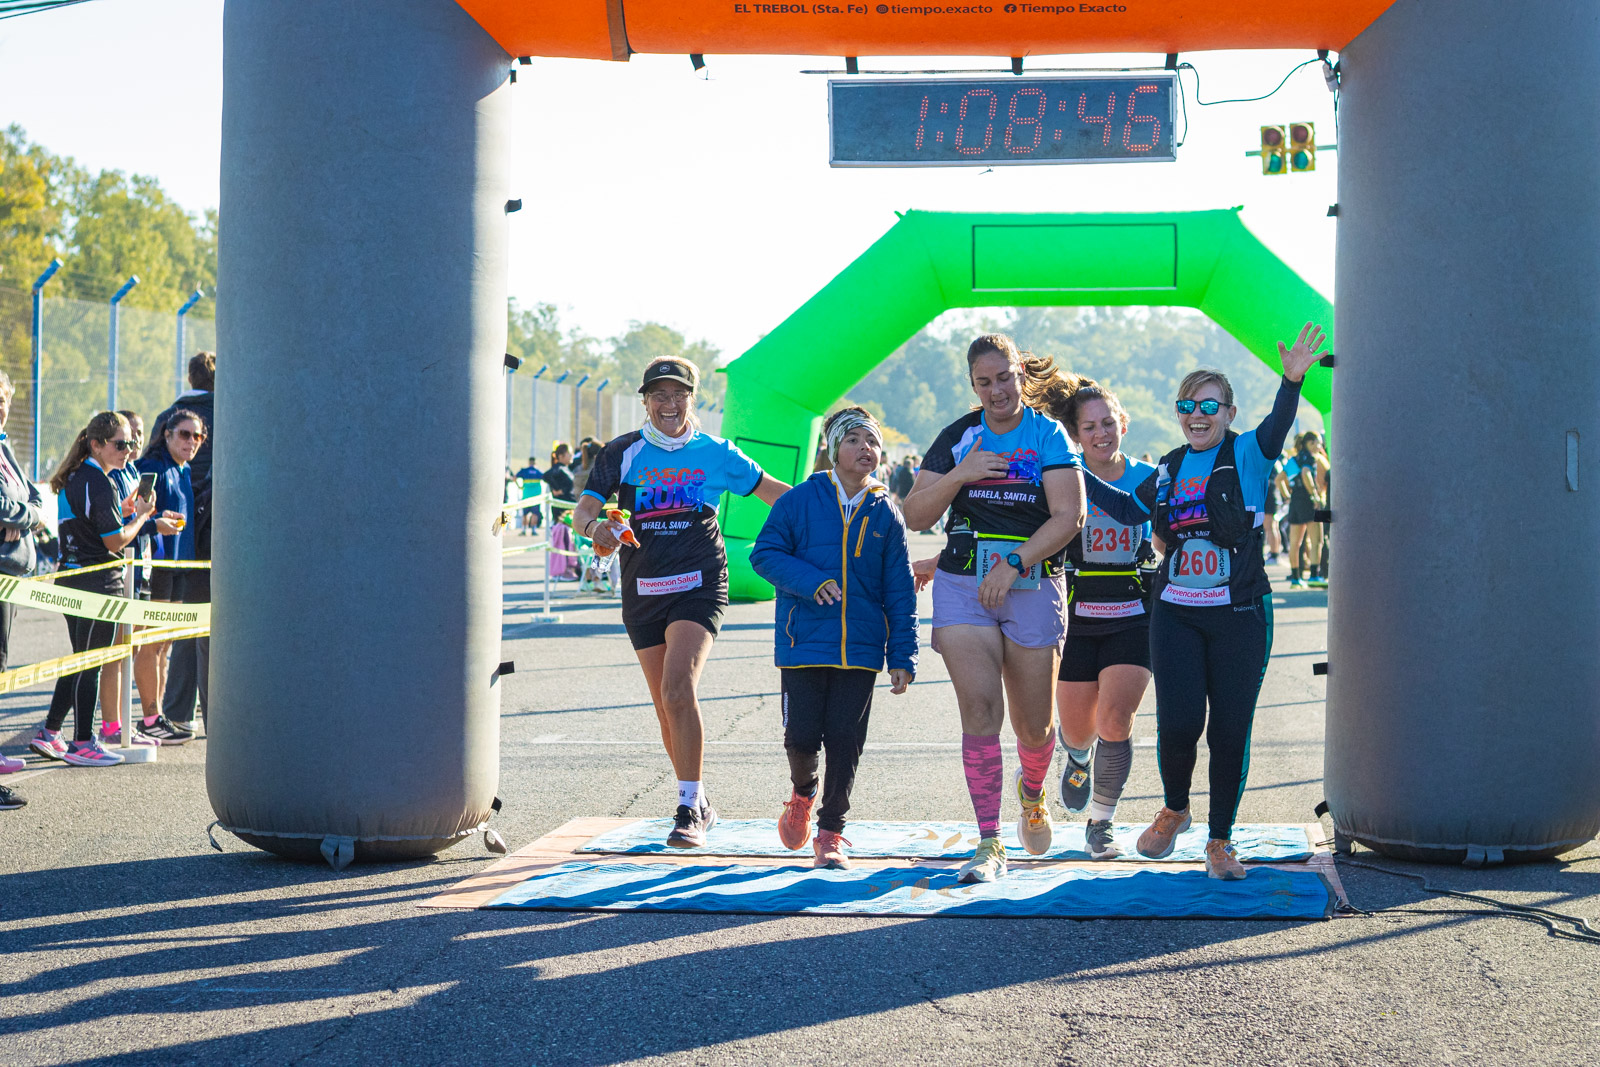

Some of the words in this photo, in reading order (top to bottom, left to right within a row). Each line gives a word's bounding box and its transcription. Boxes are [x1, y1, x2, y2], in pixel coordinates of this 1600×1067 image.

[734, 4, 751, 13] EL
[753, 4, 809, 13] TREBOL
[812, 4, 844, 14] (Sta.
[848, 4, 868, 14] Fe)
[891, 4, 993, 15] tiempo.exacto
[1019, 4, 1075, 14] Tiempo
[1079, 4, 1127, 13] Exacto
[915, 85, 1161, 154] 1:08:46
[969, 490, 1001, 500] RAFAELA,
[1003, 492, 1027, 501] SANTA
[1028, 494, 1037, 503] FE
[1092, 527, 1131, 552] 234
[1179, 550, 1218, 576] 260
[677, 573, 698, 585] Salud
[1203, 588, 1226, 598] Salud
[30, 590, 82, 610] PRECAUCION
[144, 610, 198, 622] PRECAUCION
